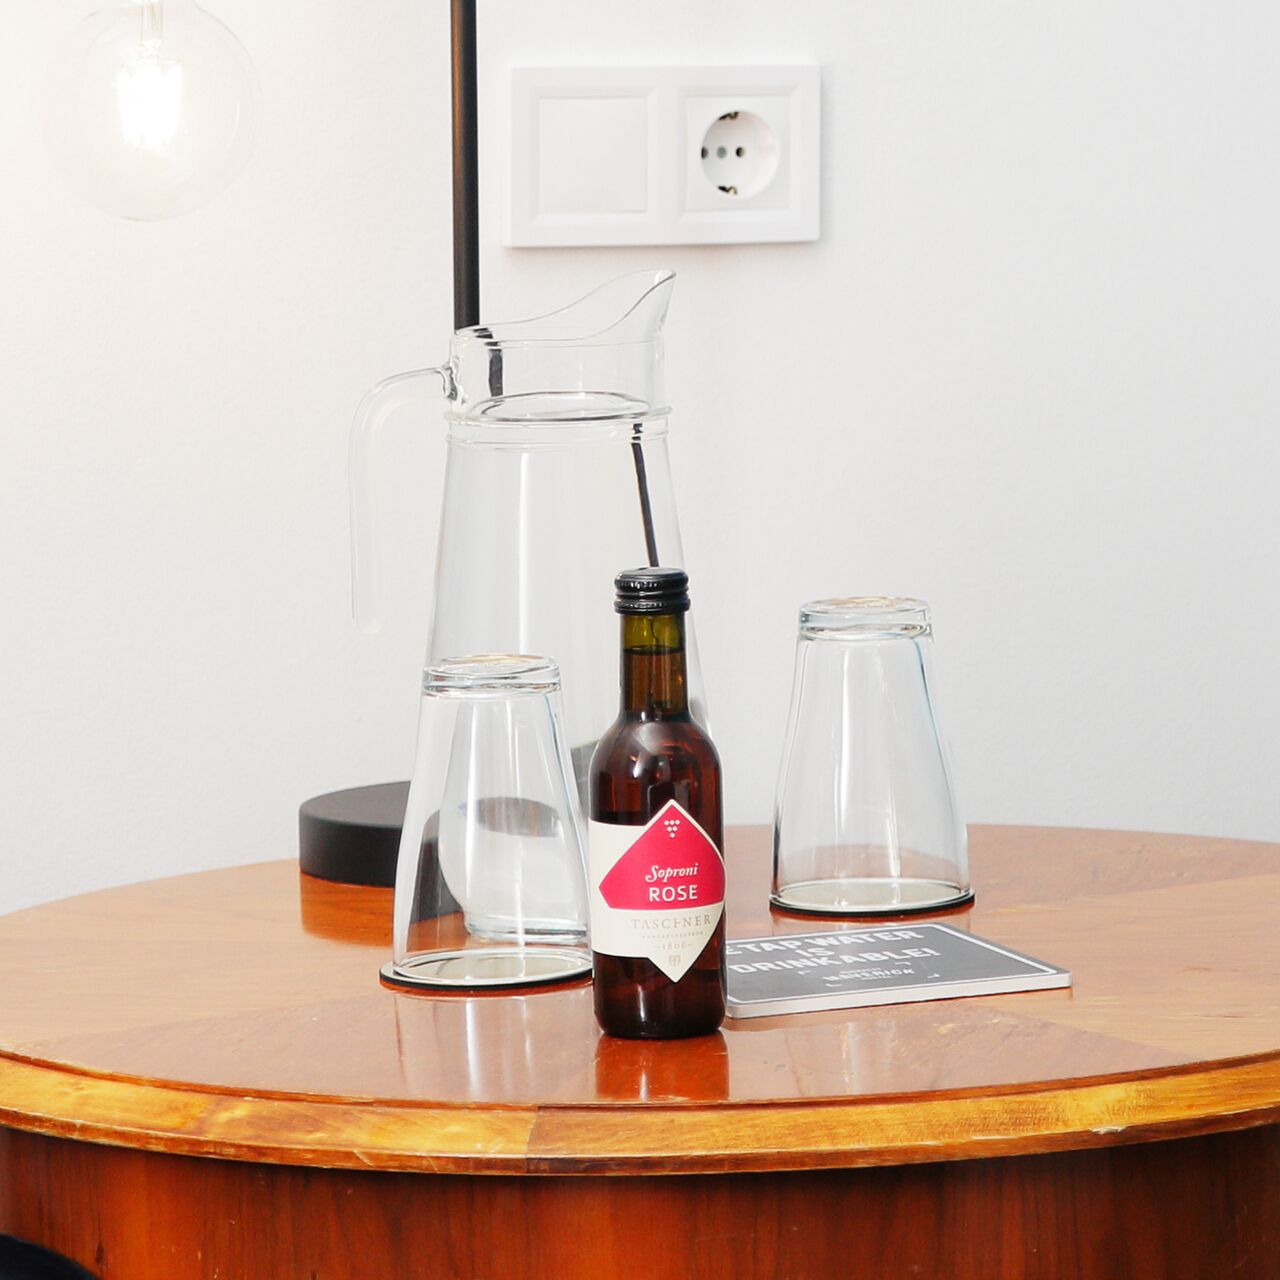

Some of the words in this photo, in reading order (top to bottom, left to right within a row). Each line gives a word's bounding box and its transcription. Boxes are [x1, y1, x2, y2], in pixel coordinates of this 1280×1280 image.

[645, 862, 699, 883] Soproni
[736, 939, 804, 953] TAP
[806, 930, 925, 947] WATER
[795, 947, 836, 958] IS
[728, 947, 942, 974] DRINKABLE!
